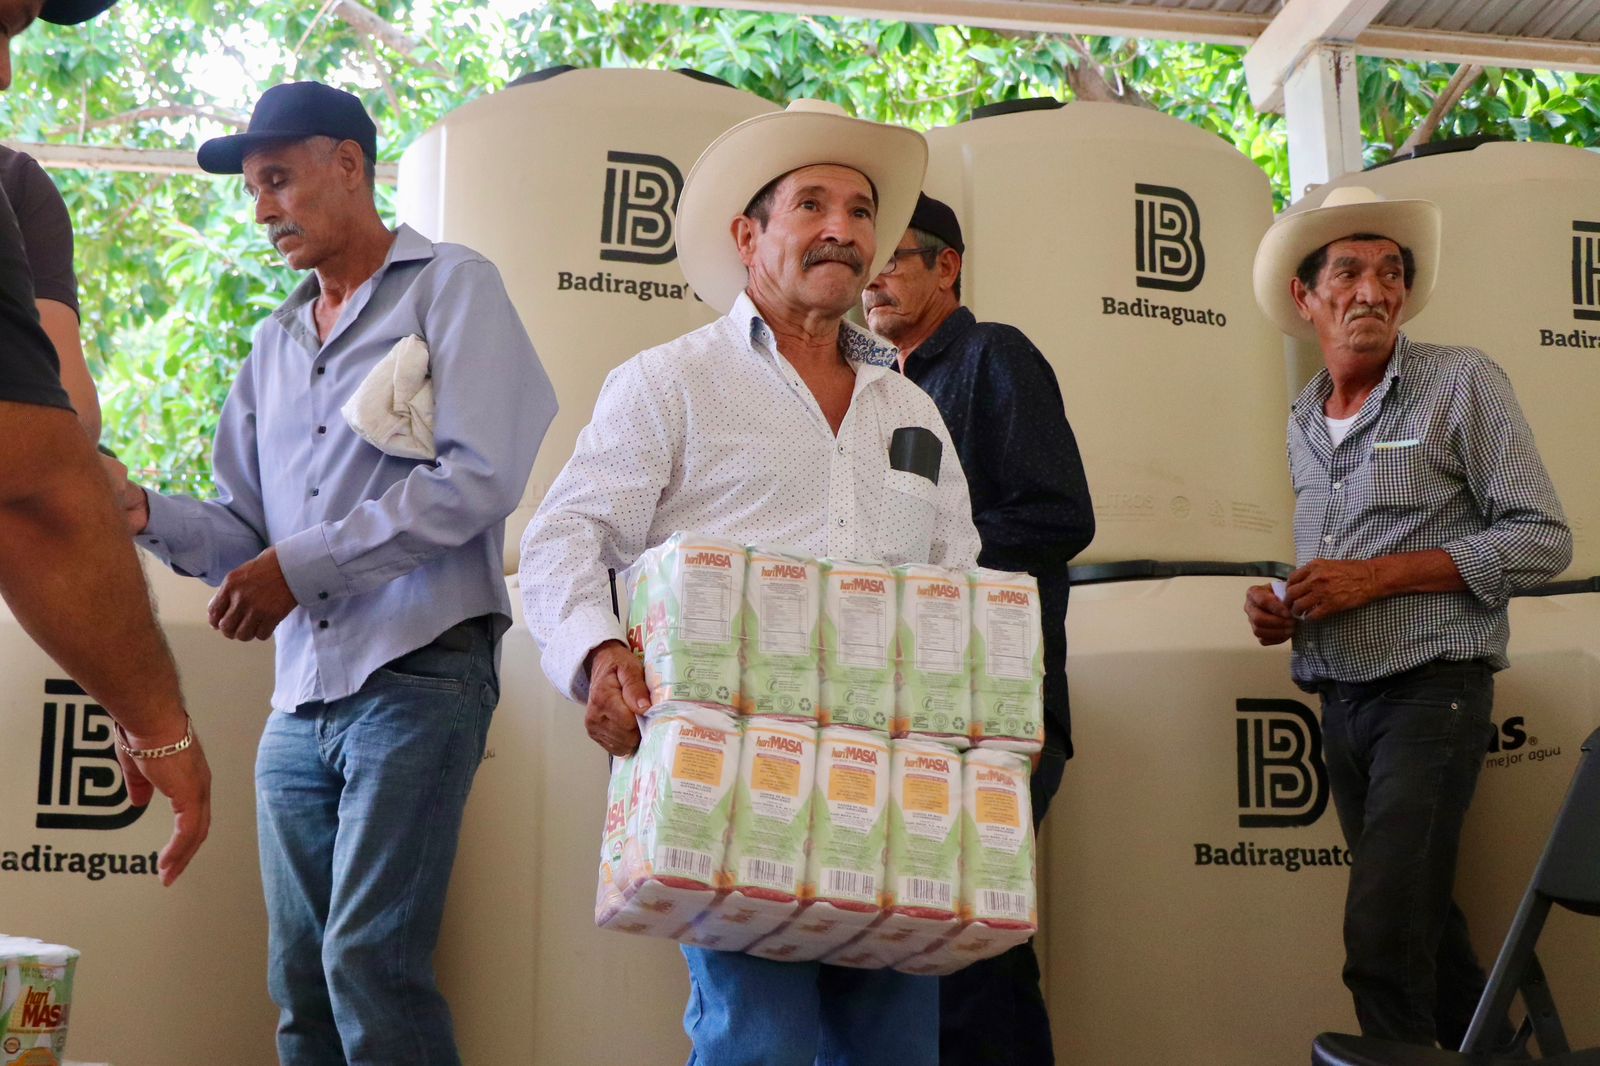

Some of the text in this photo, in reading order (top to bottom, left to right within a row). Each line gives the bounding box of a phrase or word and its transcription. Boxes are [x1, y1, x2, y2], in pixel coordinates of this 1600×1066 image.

[557, 272, 703, 301] Badiragua
[1101, 297, 1227, 327] Badiraguato
[1486, 752, 1524, 768] mejor
[0, 845, 159, 881] adiraguat
